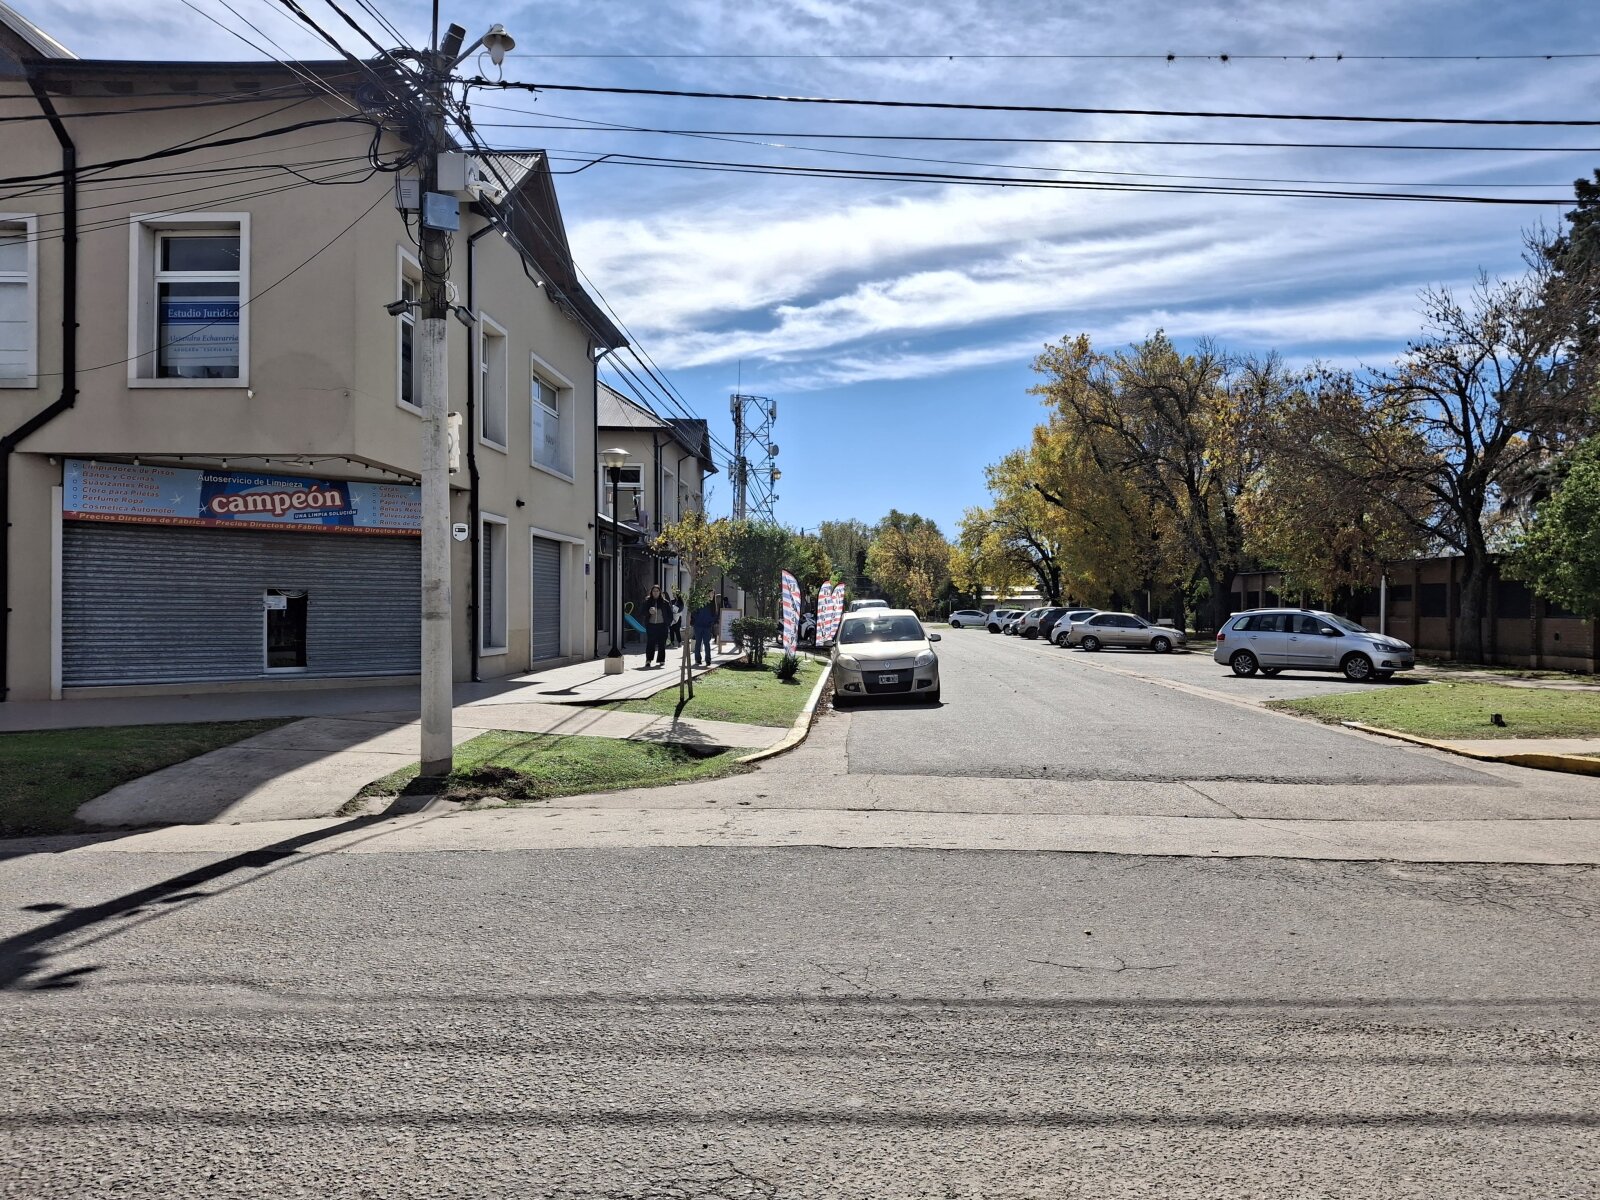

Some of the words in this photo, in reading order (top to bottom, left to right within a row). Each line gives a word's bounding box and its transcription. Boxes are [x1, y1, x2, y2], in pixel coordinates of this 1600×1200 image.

[168, 308, 201, 318] Estudio
[82, 463, 137, 474] Limpiadores
[152, 468, 176, 476] Pisos
[120, 474, 155, 482] Cocinas
[198, 475, 252, 485] Autoservicio
[254, 478, 264, 486] de
[266, 479, 303, 489] Limpieza
[82, 479, 135, 488] Suavizantes
[138, 482, 160, 491] Ropa
[82, 494, 119, 503] Perfume
[121, 497, 144, 505] Ropa
[131, 490, 160, 498] Piletas
[212, 486, 341, 514] campeón
[131, 506, 176, 514] Automotor
[79, 513, 116, 521] Precios
[118, 514, 157, 523] Directos
[249, 521, 284, 529] Directos
